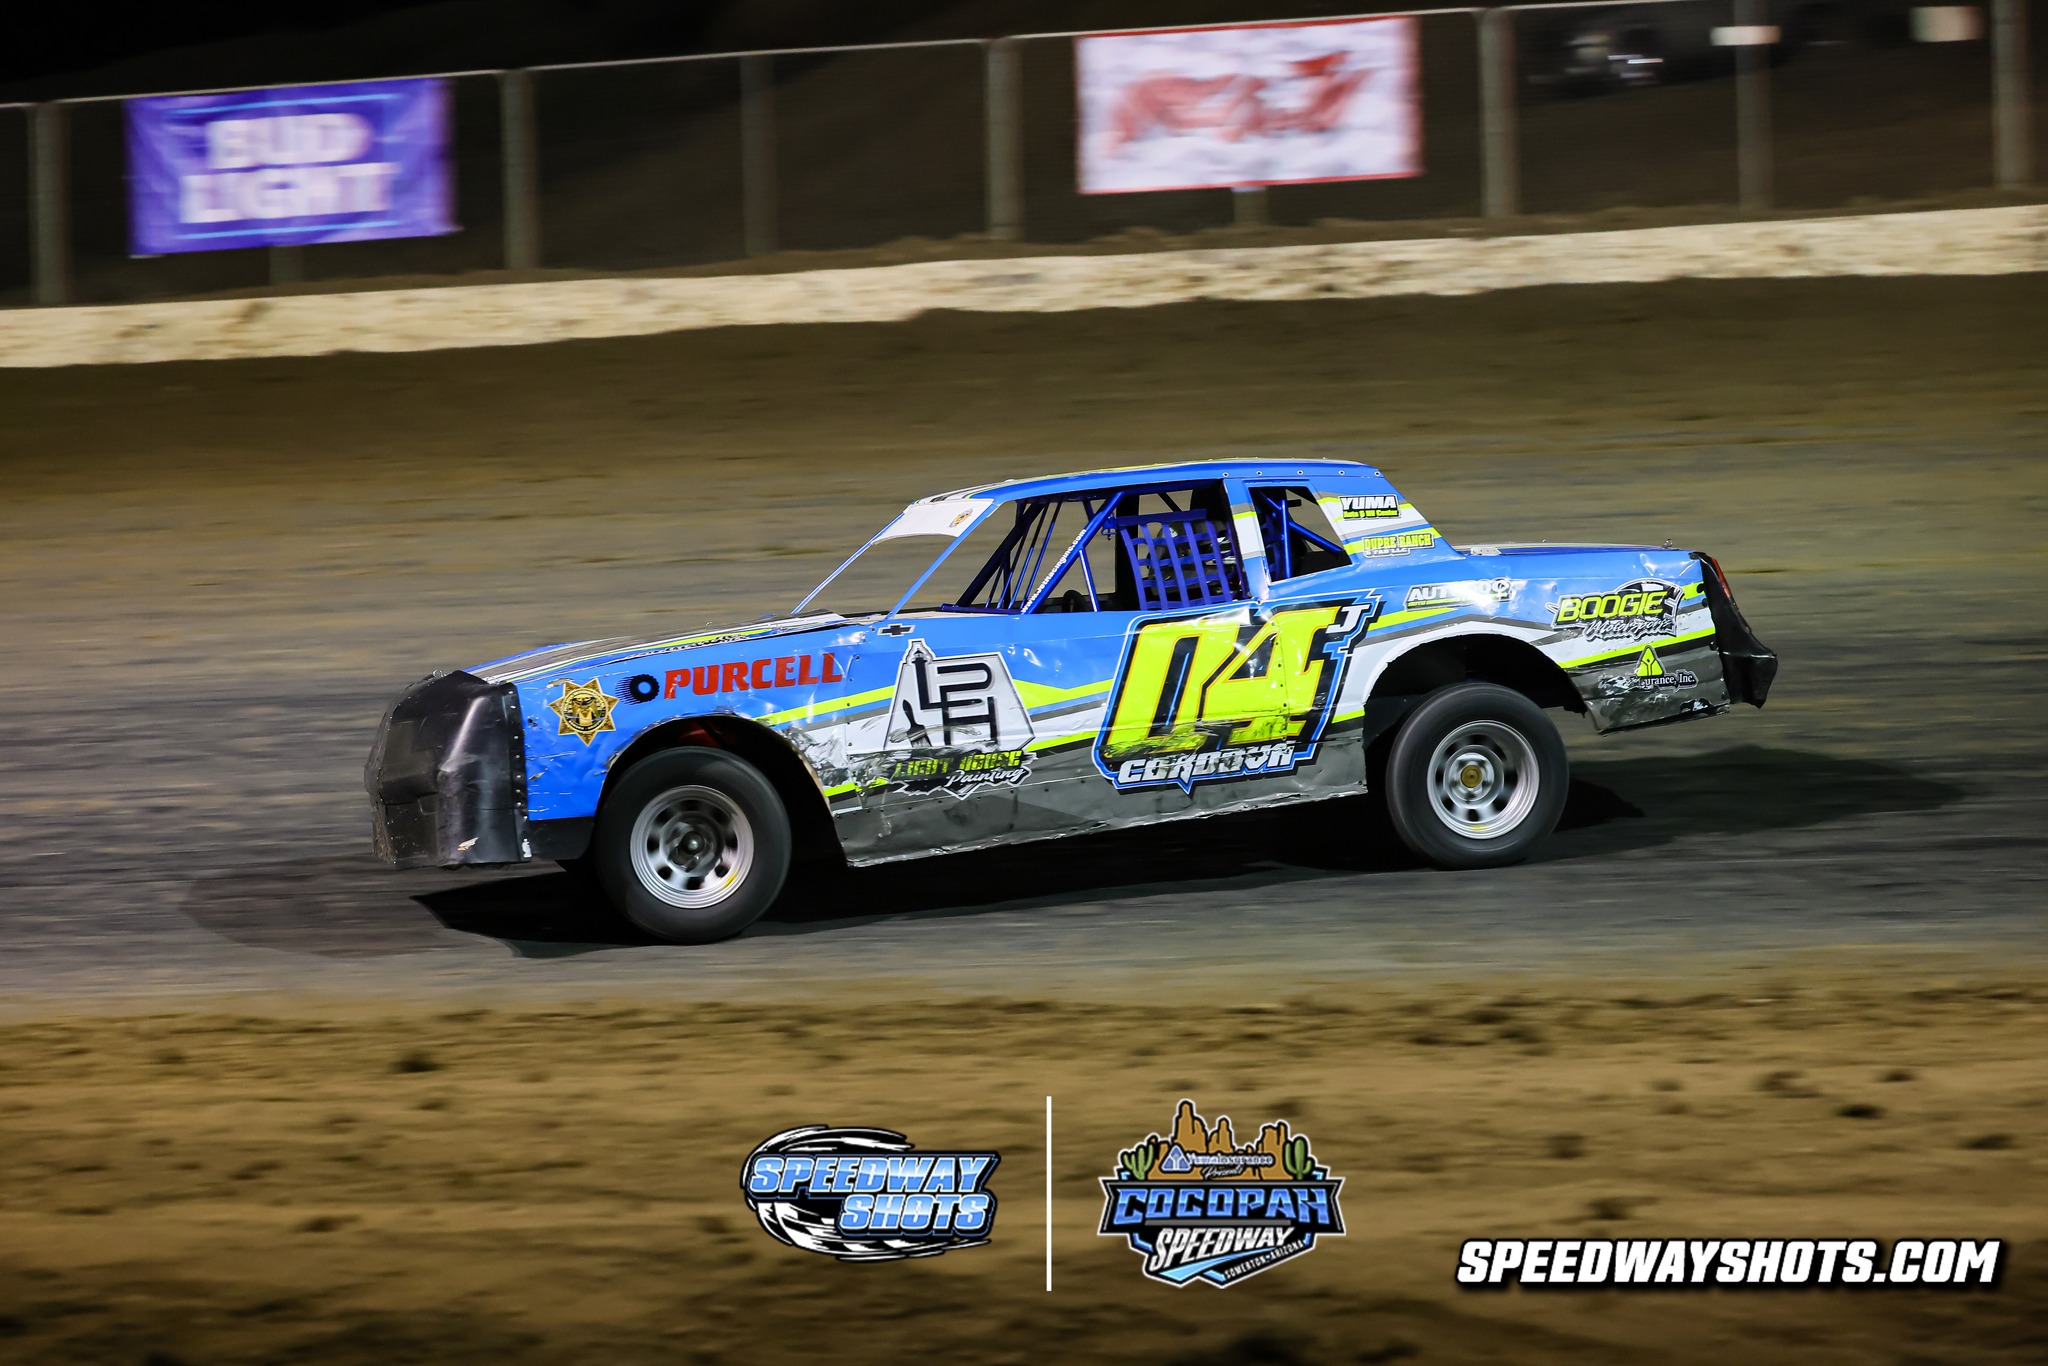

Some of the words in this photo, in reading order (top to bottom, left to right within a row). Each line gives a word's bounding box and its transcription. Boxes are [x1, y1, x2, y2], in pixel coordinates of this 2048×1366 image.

[206, 113, 371, 169] BUD
[180, 162, 398, 223] LIGHT
[1340, 496, 1396, 510] YUMA
[1364, 536, 1396, 549] DUPRE
[1399, 533, 1432, 547] RANCH
[1557, 591, 1668, 622] BOOGIE
[1586, 618, 1673, 634] Motorsports
[664, 653, 843, 699] PURCELL
[1104, 606, 1342, 758] 04
[1679, 673, 1695, 683] Inc.
[945, 768, 1026, 787] Painting
